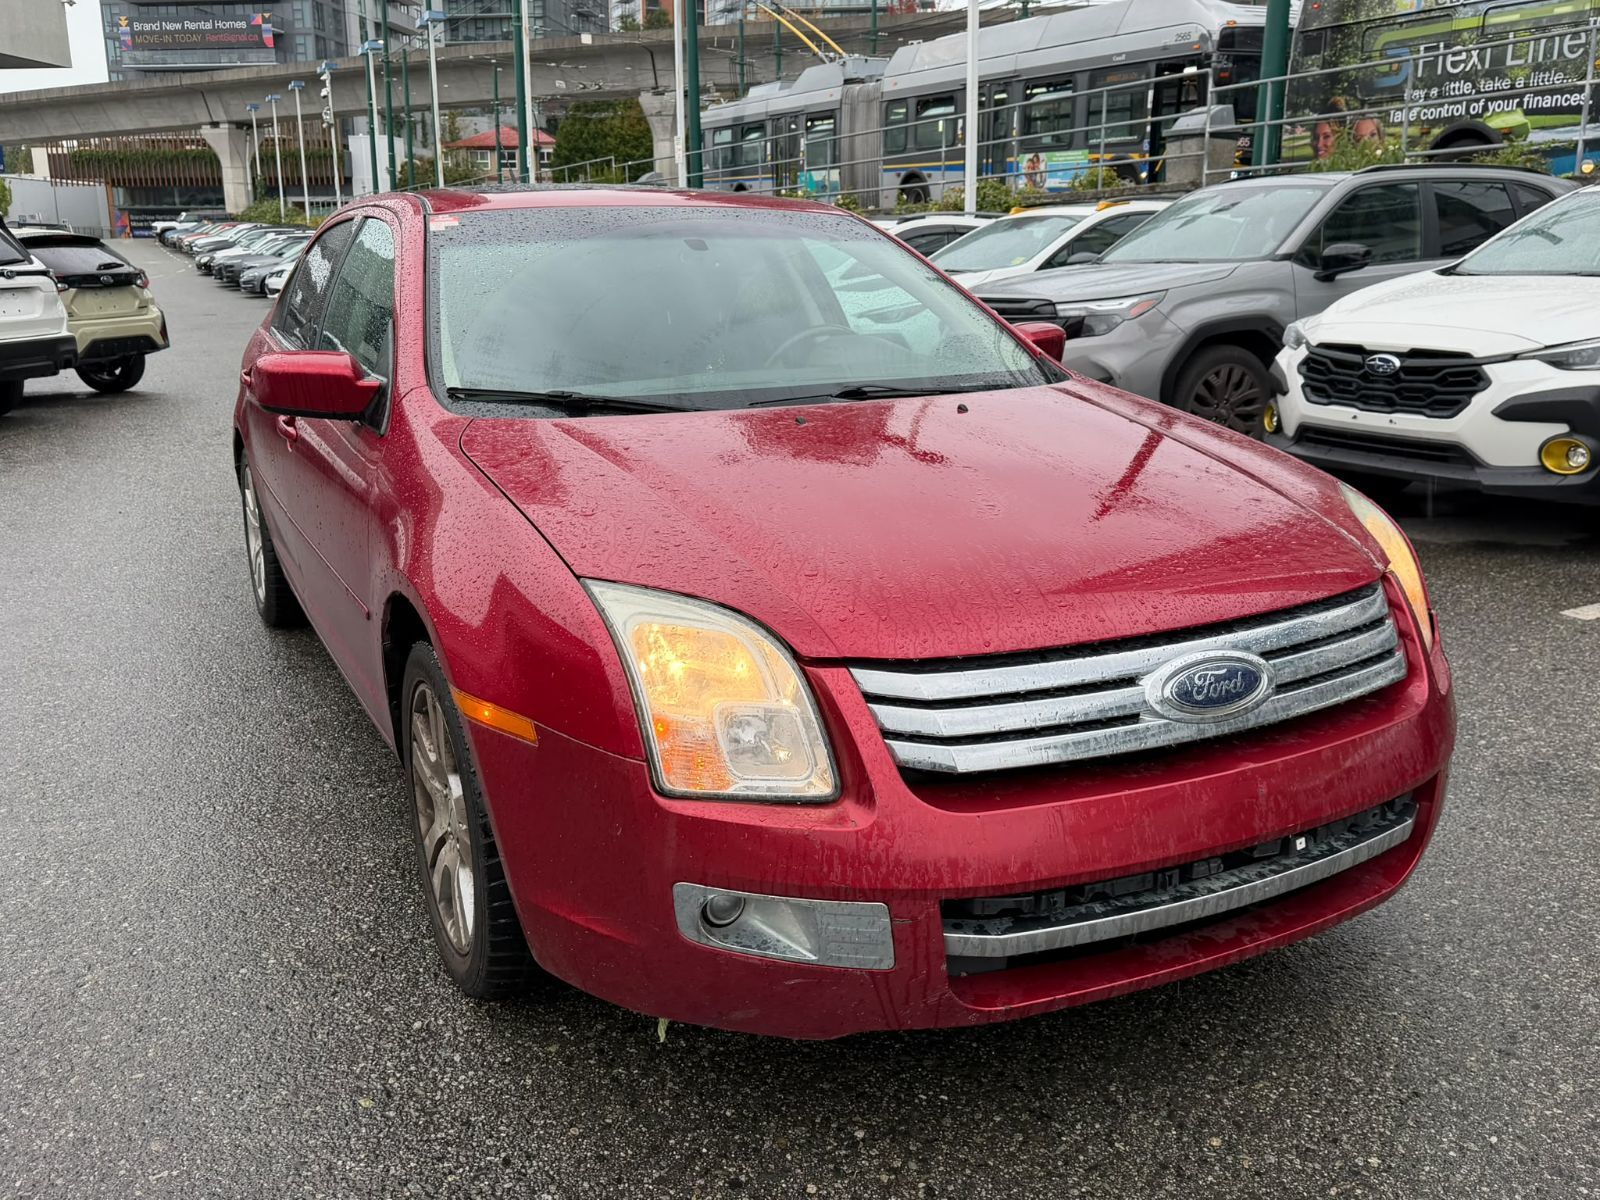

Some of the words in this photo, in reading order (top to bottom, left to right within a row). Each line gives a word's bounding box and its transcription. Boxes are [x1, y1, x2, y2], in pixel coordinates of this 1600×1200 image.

[133, 21, 160, 31] Brand
[162, 21, 182, 30] New
[184, 19, 213, 30] Rental
[214, 20, 247, 29] Homes
[135, 34, 172, 43] MOVE-IN
[174, 34, 201, 42] TODAY
[206, 32, 259, 43] RentSignal.ca
[1175, 31, 1192, 42] 2565
[1417, 36, 1493, 77] Flexi
[1506, 29, 1587, 66] Line
[1430, 87, 1439, 98] a
[1480, 76, 1511, 91] take
[1515, 76, 1525, 88] a
[1530, 68, 1577, 86] little...
[1421, 101, 1466, 120] control
[1470, 98, 1486, 115] of
[1488, 98, 1520, 116] your
[1523, 92, 1593, 109] finances.
[1193, 668, 1244, 701] Ford
